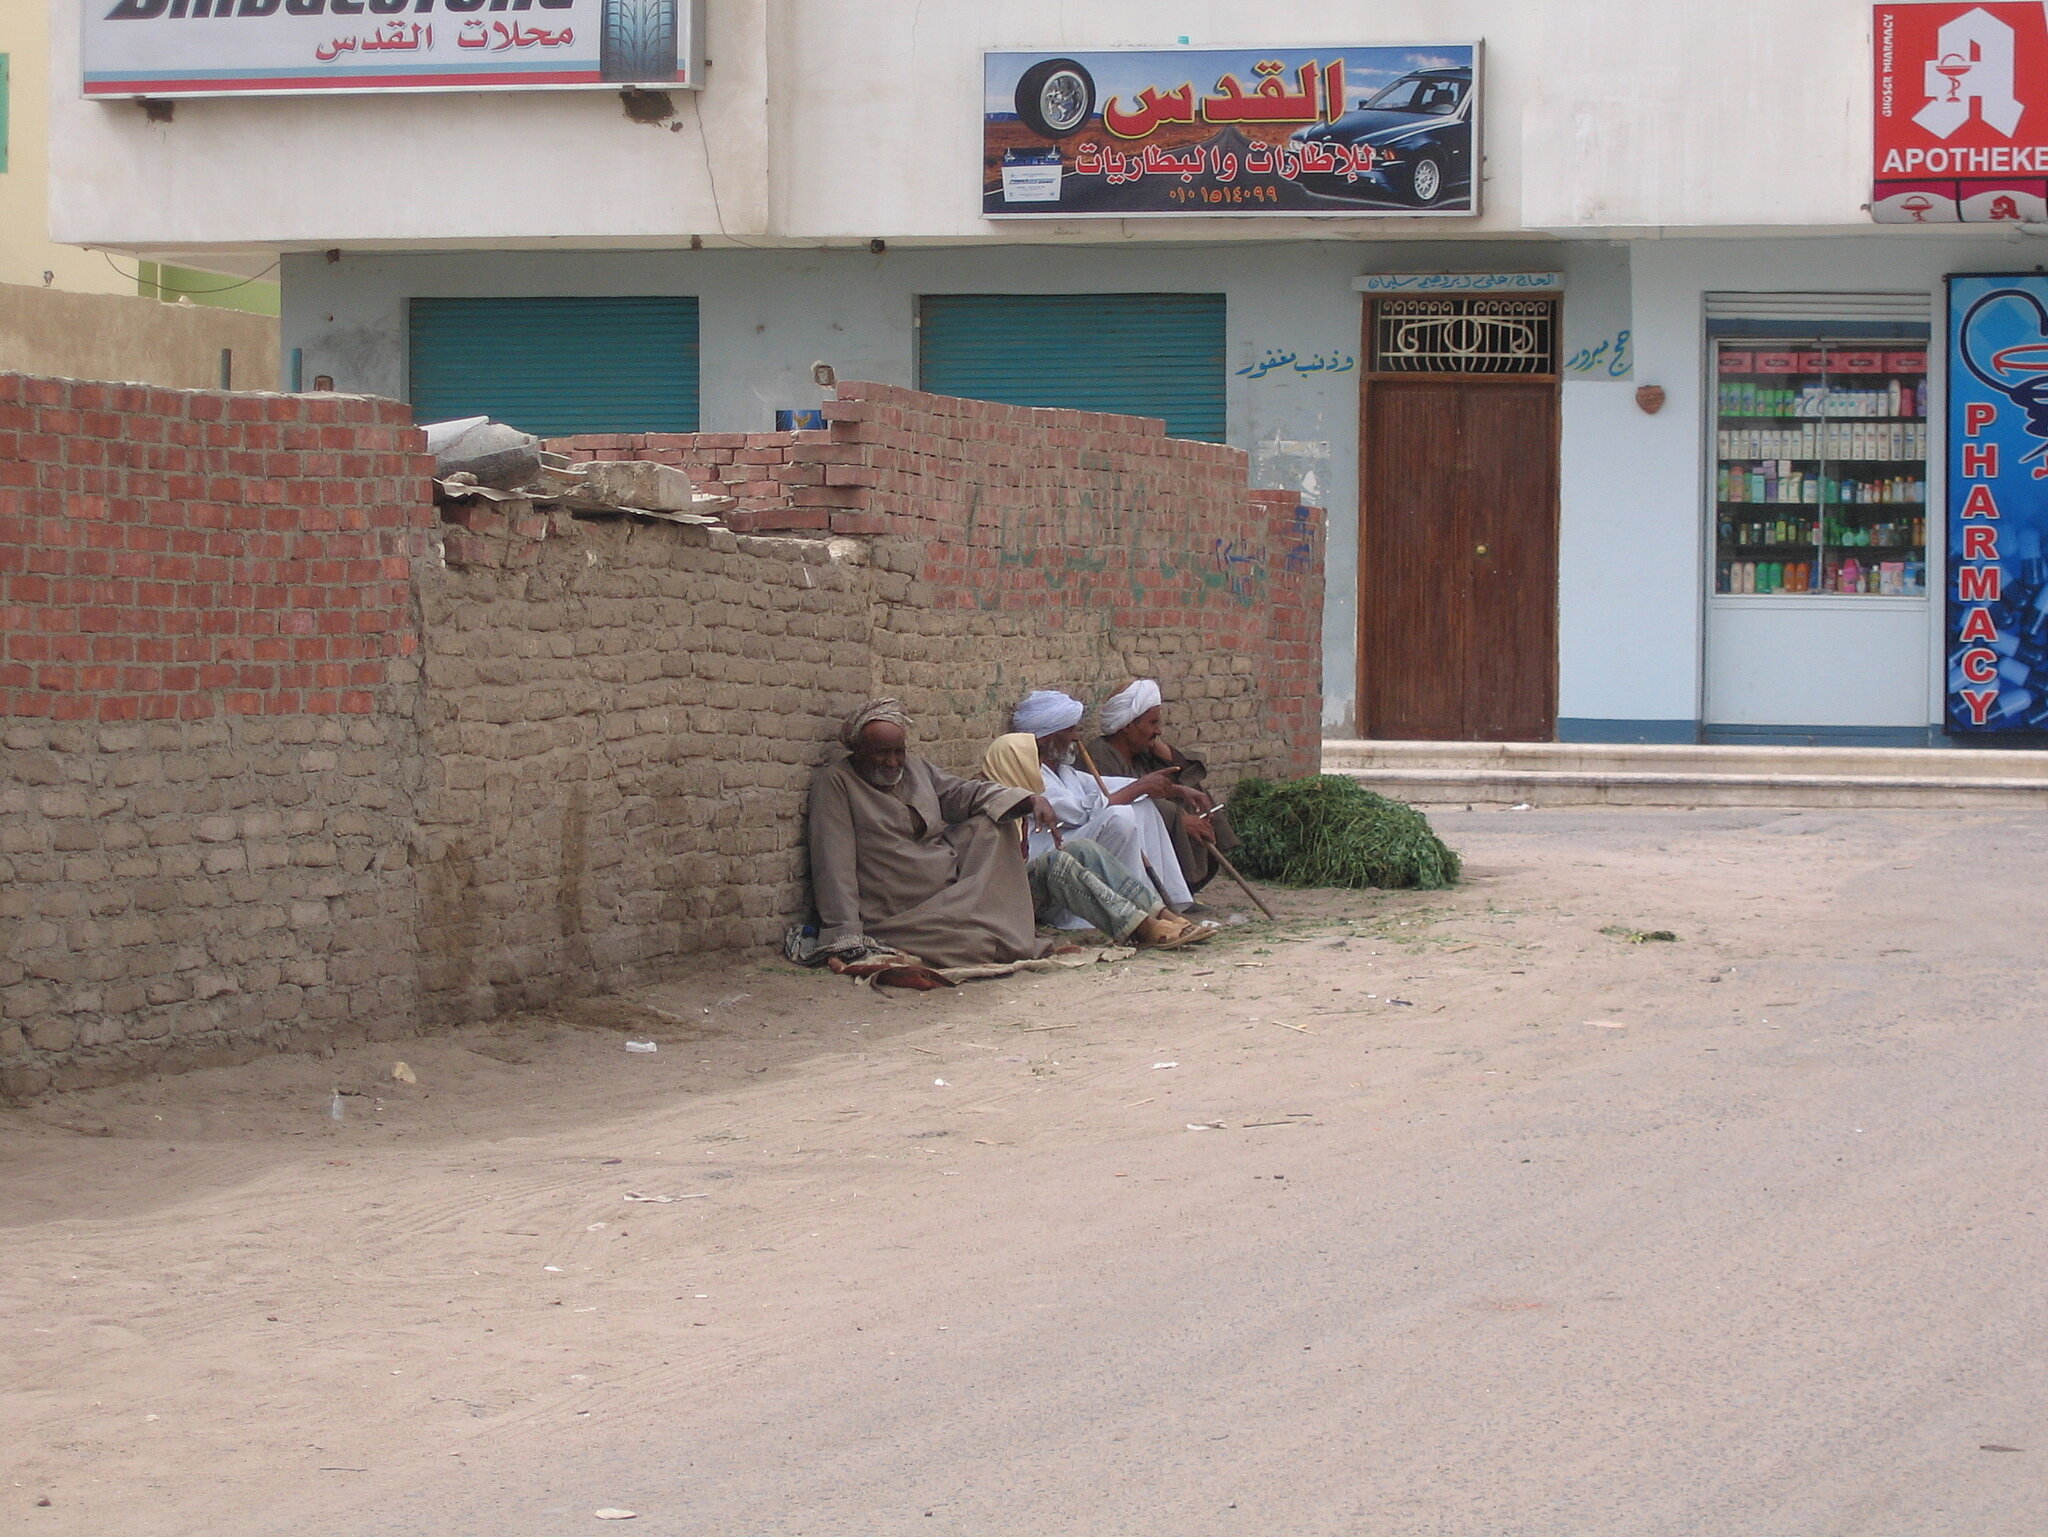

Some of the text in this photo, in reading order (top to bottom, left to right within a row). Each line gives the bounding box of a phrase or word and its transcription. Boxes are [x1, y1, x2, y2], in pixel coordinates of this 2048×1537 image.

[315, 19, 576, 61] محلات القدس
[1882, 14, 1894, 74] PHARMACY
[1104, 57, 1346, 140] القدس
[1074, 142, 1239, 184] والبطاريات
[1881, 146, 2048, 174] APOTHEKE
[1234, 348, 1297, 379] مغفور
[1564, 329, 1633, 377] حج مبرور
[1959, 402, 2001, 726] PHARMACY
